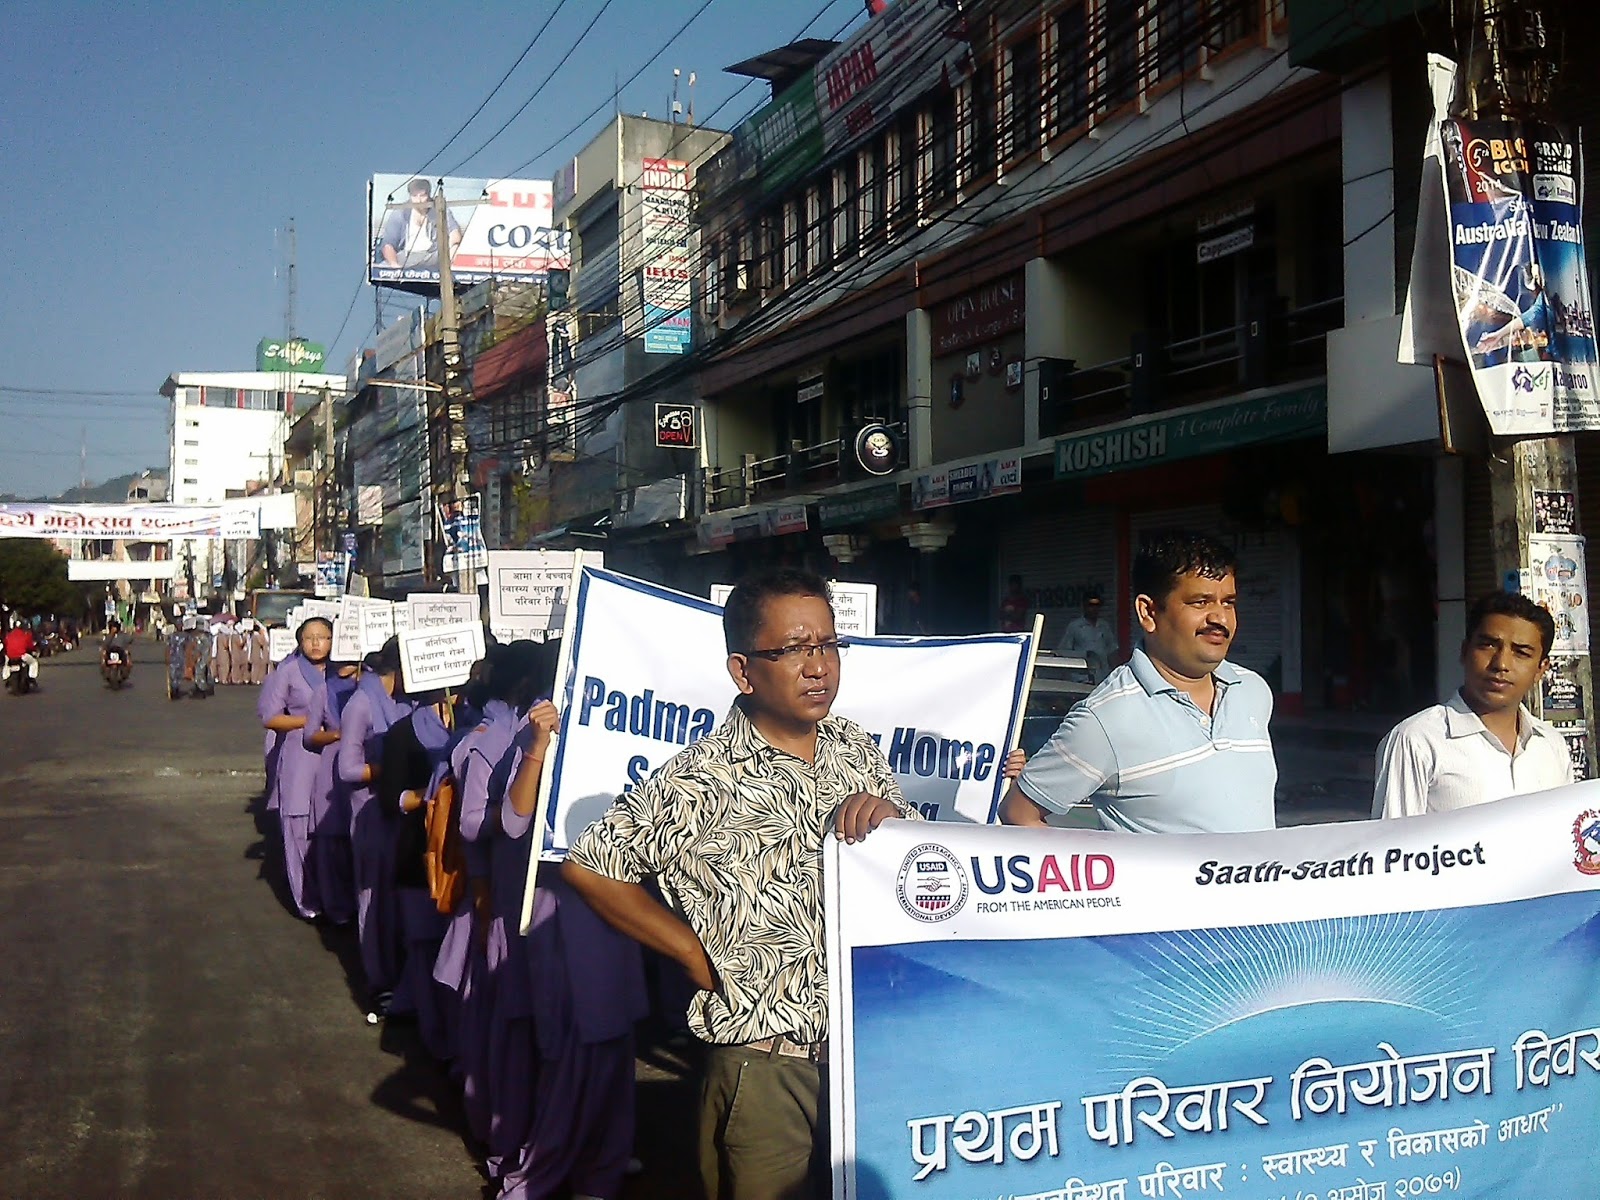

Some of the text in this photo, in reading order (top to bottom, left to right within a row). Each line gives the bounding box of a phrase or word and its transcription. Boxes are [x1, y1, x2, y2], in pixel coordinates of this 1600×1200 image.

[643, 169, 687, 189] INDIA
[646, 267, 688, 279] IELTS
[1552, 367, 1588, 390] Kaaroo
[1189, 408, 1258, 437] Complete
[1263, 393, 1320, 422] Family
[660, 431, 683, 440] OPEN
[1058, 425, 1167, 473] KOSHISH
[1000, 460, 1017, 470] LUX
[932, 475, 945, 483] LUX
[513, 572, 532, 580] आमा
[536, 572, 541, 580] र
[501, 585, 529, 593] स्वास्थ्य
[514, 595, 541, 605] परिवार
[838, 607, 857, 617] लागि
[835, 621, 859, 631] योजन
[415, 659, 473, 674] परिवार नियोजन
[578, 675, 995, 782] Padma Home
[902, 849, 918, 872] UNITED
[940, 848, 961, 870] AGENCY
[920, 862, 945, 871] USAID
[1384, 841, 1486, 876] Project
[970, 853, 1115, 895] USAID
[898, 883, 967, 921] INTERNATIONAL DEVELOPMENT
[977, 896, 1122, 913] FROM THE AMERICAN PEOPLE
[907, 1099, 1062, 1182] प्रथम
[1080, 1074, 1273, 1147] परिवार
[1289, 1041, 1496, 1121] नियोजन
[1137, 1161, 1227, 1199] परिवार
[1262, 1142, 1349, 1181] स्वास्थ्य
[1359, 1139, 1378, 1168] र
[1386, 1118, 1490, 1160] विकासको
